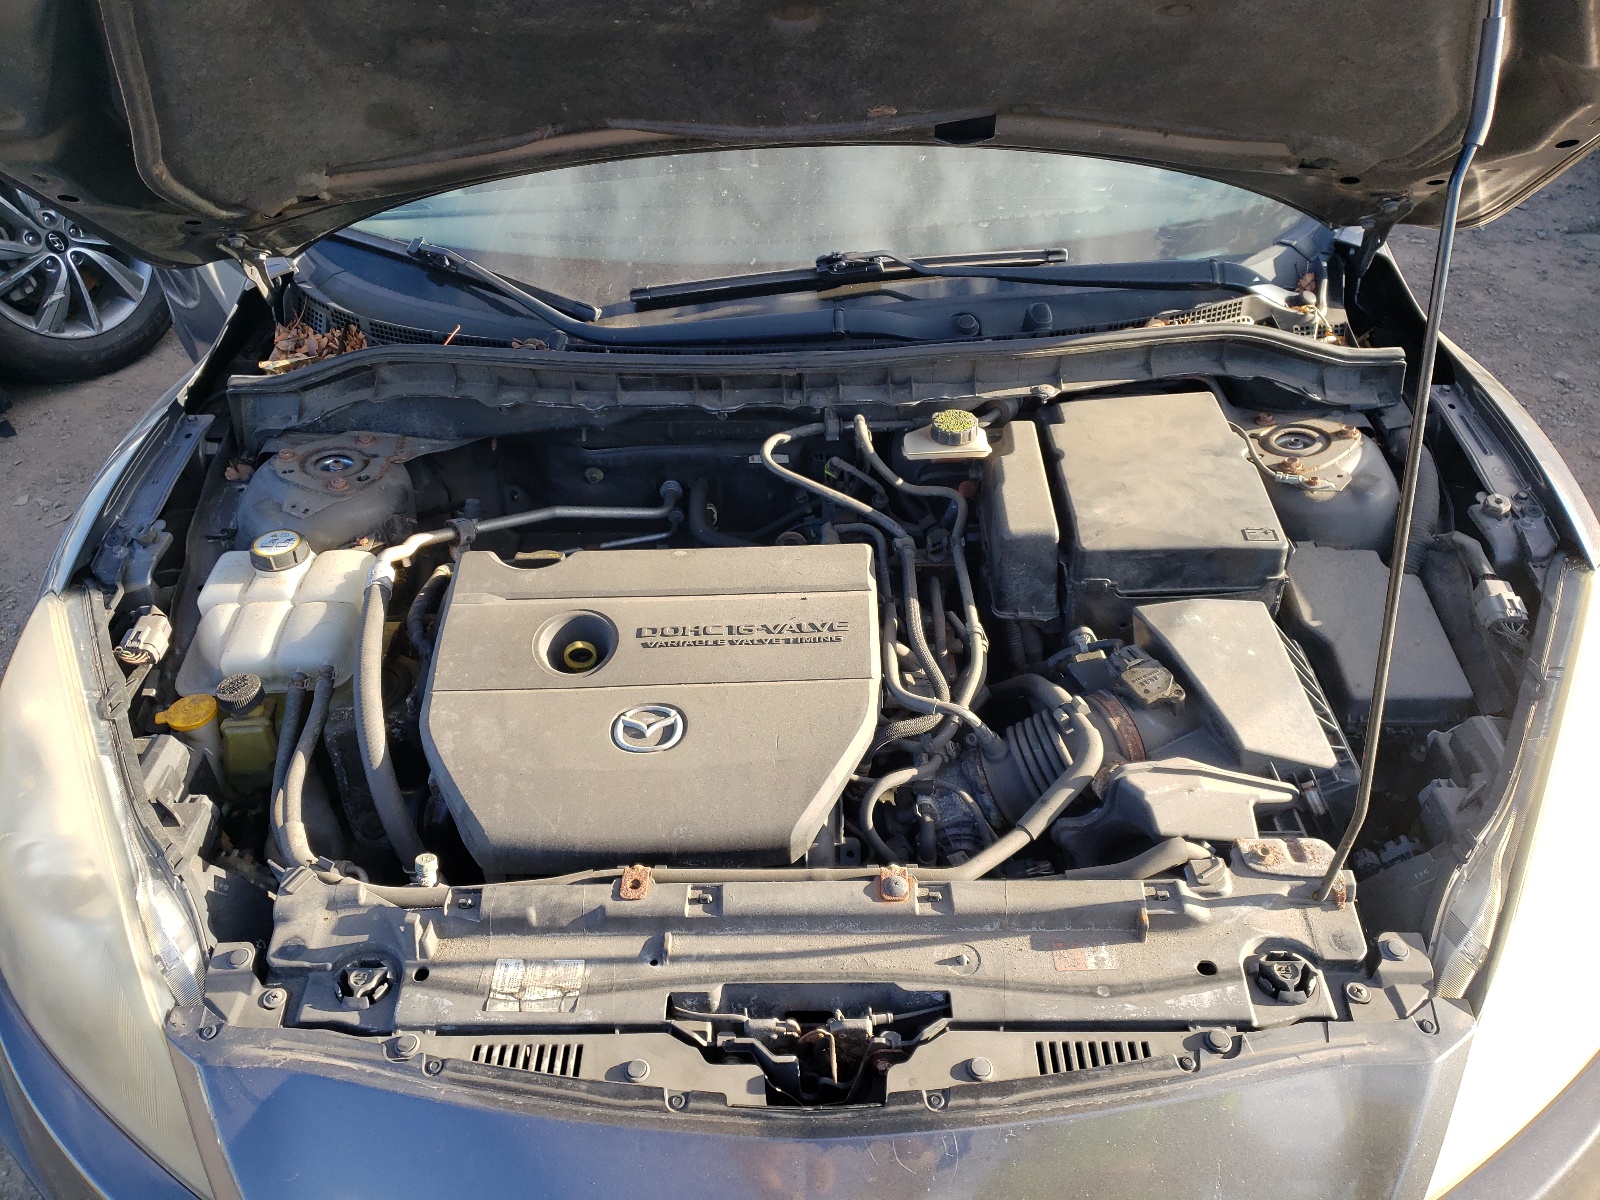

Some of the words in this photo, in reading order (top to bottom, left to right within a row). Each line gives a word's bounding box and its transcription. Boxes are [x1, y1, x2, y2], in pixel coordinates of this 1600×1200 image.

[635, 624, 724, 639] DOHC
[725, 621, 850, 636] 16-VALVE
[641, 639, 726, 649] VARIABLE
[727, 637, 782, 646] VALVE
[782, 635, 843, 645] TIMING
